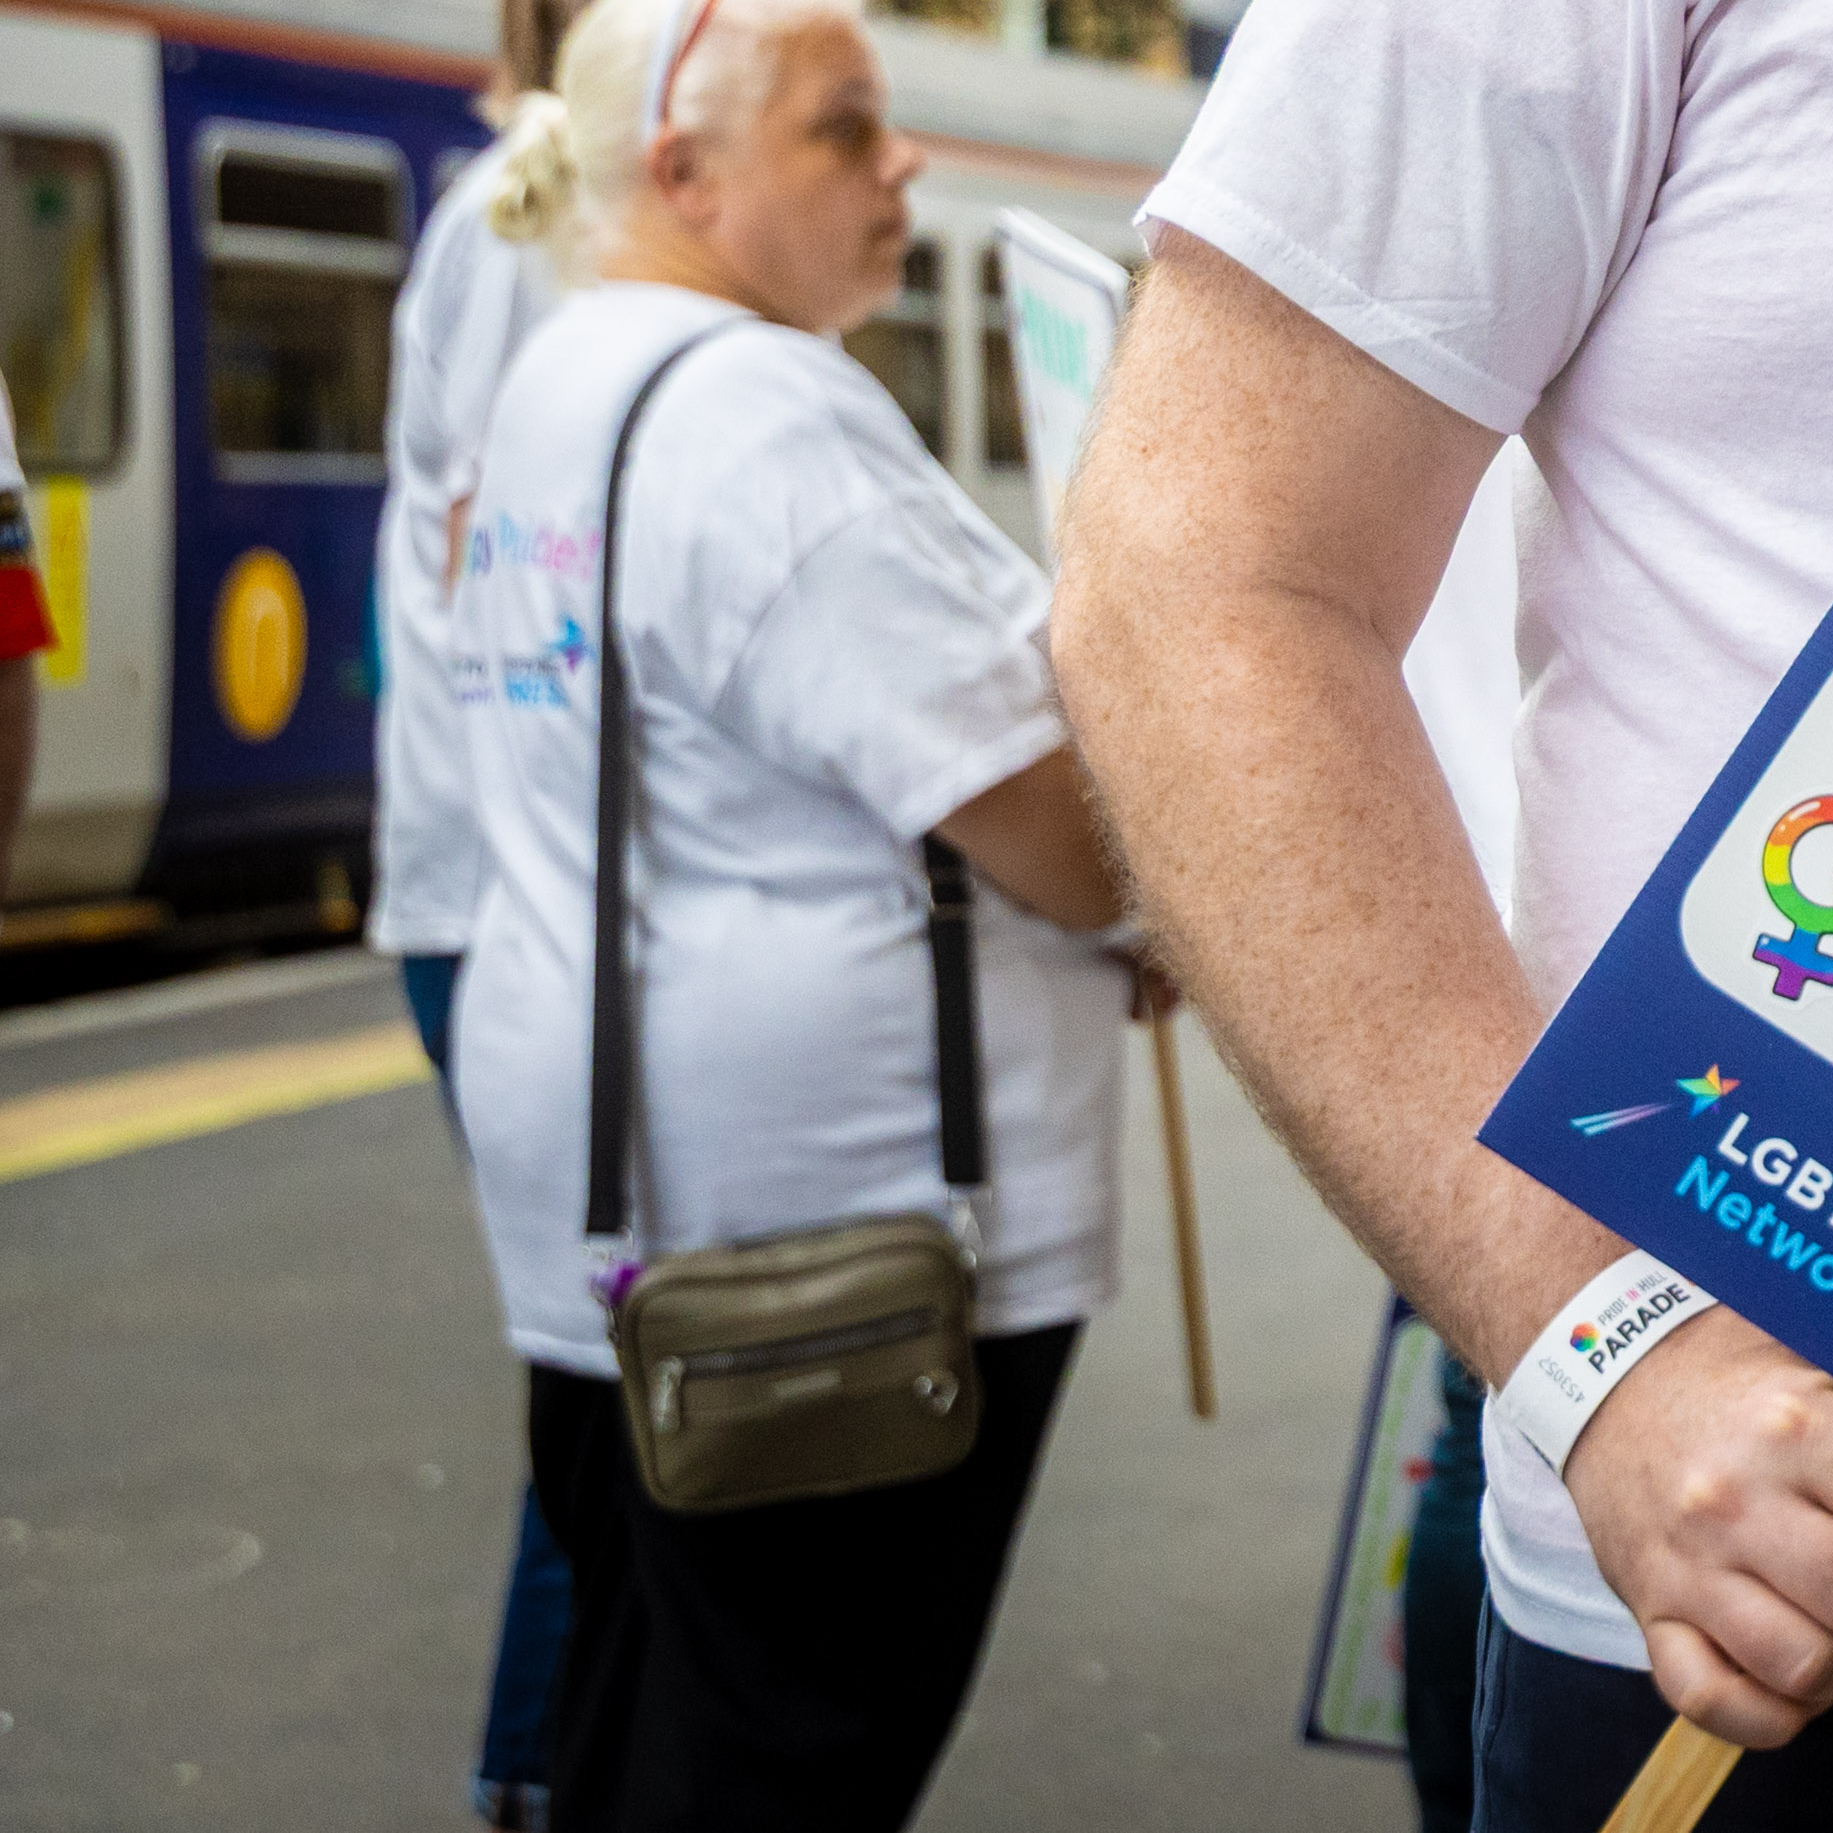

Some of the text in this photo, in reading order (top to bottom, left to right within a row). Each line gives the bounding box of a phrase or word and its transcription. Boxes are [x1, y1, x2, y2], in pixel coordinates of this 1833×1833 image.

[1588, 1283, 1691, 1375] PARADE
[1598, 1271, 1668, 1325] PRIDE IN HULL
